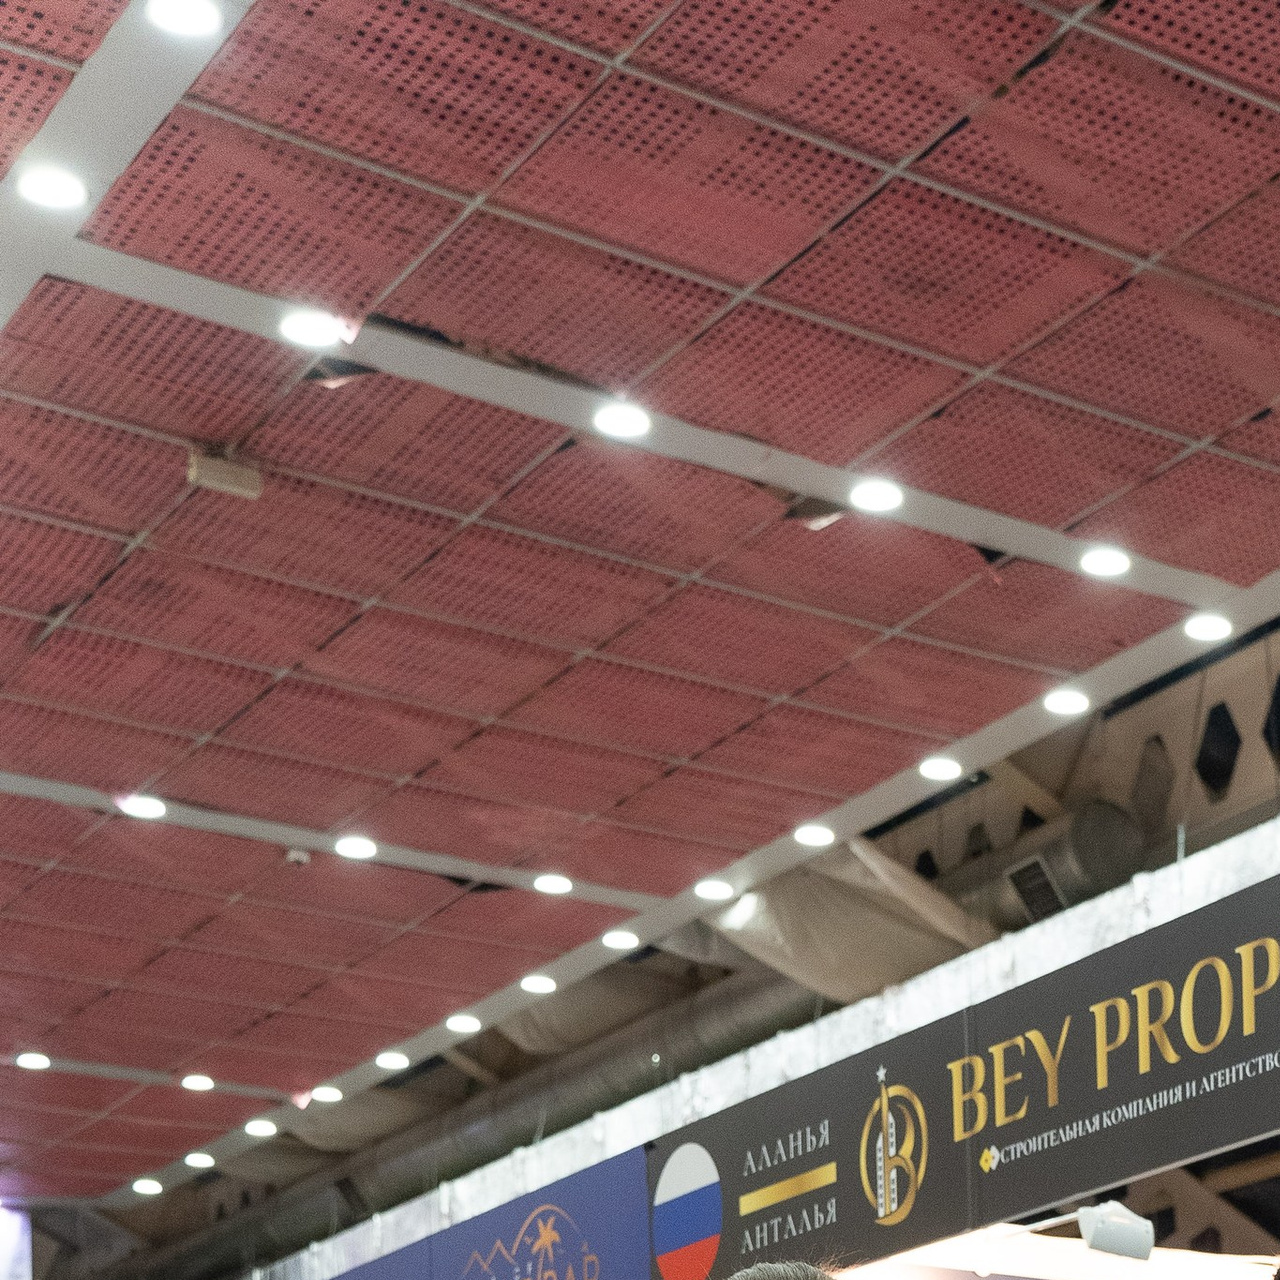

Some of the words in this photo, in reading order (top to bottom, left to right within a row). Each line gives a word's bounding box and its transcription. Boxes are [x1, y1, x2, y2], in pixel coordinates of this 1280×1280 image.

[947, 1014, 1072, 1144] BEY
[743, 1119, 829, 1177] АЛАНЬЯ
[1001, 1113, 1099, 1164] СТРОИТЕЛЬНАЯ
[1102, 1086, 1182, 1129] КОМПАНИЯ
[1185, 1080, 1197, 1099] И
[742, 1198, 837, 1254] АНТАЛЬЯ
